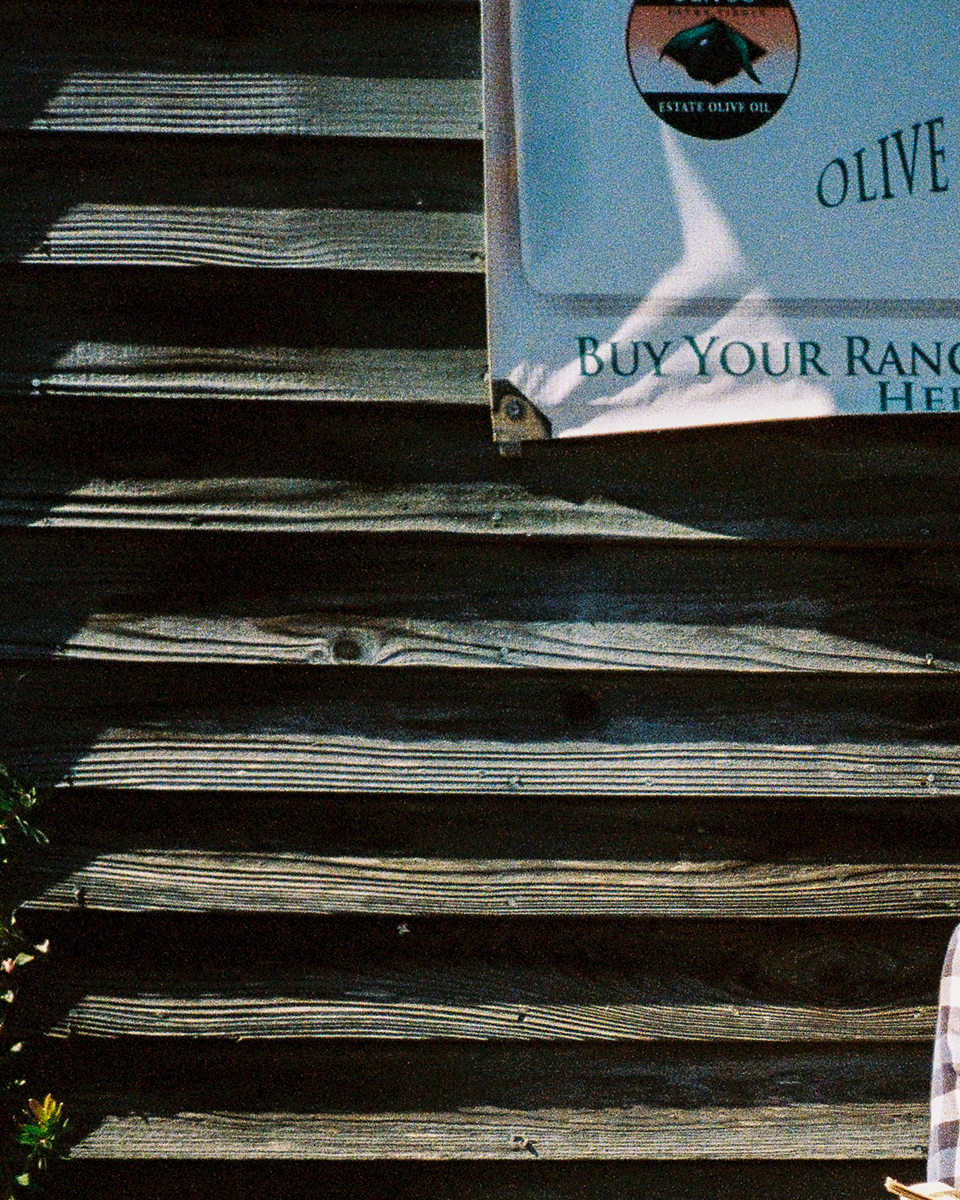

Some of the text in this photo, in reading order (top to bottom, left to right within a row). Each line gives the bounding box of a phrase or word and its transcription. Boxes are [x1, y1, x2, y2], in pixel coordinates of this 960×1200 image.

[659, 101, 705, 113] ESTATE
[708, 101, 745, 113] OLIVE
[816, 116, 950, 209] OLIVE
[576, 335, 673, 378] BUY
[683, 335, 831, 378] YOUR
